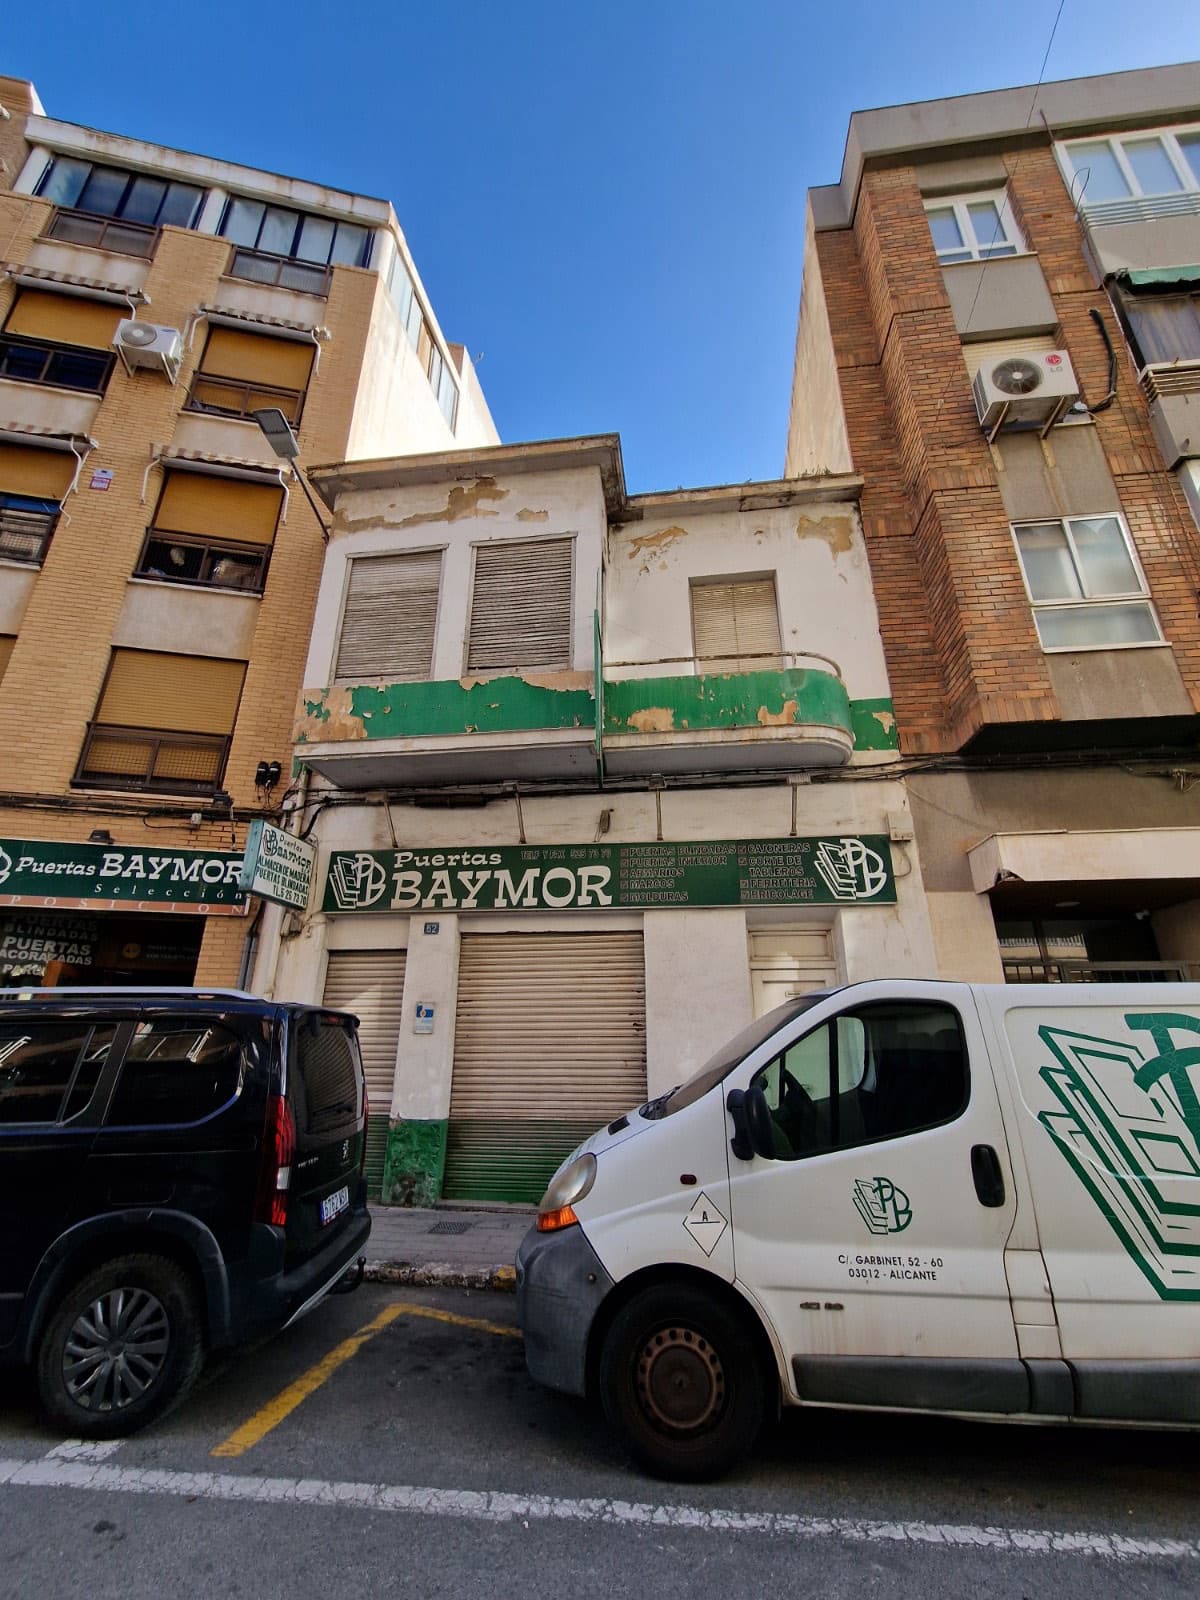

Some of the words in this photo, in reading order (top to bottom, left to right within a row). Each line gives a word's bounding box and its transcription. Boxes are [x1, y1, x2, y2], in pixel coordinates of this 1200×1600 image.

[280, 834, 302, 853] Puertas
[748, 843, 810, 854] CAJONERAS
[630, 846, 676, 856] PUERTAS
[677, 844, 737, 856] BLINDADAS
[277, 846, 311, 869] BAYMOR
[393, 851, 502, 869] Puertas
[630, 857, 676, 867] PUERTAS
[678, 855, 727, 866] INTERIOR
[749, 856, 785, 866] CORTE
[786, 855, 802, 866] DE
[15, 856, 96, 876] Puertas
[99, 853, 243, 885] BAYMOR
[630, 867, 685, 878] ARMARIOS
[750, 867, 804, 878] TABLEROS
[256, 866, 280, 885] PUERTAS
[281, 876, 309, 896] BLINDADAS
[390, 865, 612, 909] BAYMOR
[630, 879, 675, 889] MARCOS
[94, 883, 242, 899] Selección
[630, 891, 688, 902] MOLDURAS
[4, 923, 98, 941] BLINDADAS
[425, 924, 437, 933] 52
[2, 936, 91, 956] PUERTAS
[0, 948, 92, 966] ACORAZADAS
[702, 1211, 709, 1222] A
[855, 1255, 905, 1267] GARBINET,
[908, 1257, 921, 1267] 52
[931, 1258, 943, 1267] 60
[848, 1268, 880, 1279] 03012
[890, 1270, 937, 1280] ALICANTE
